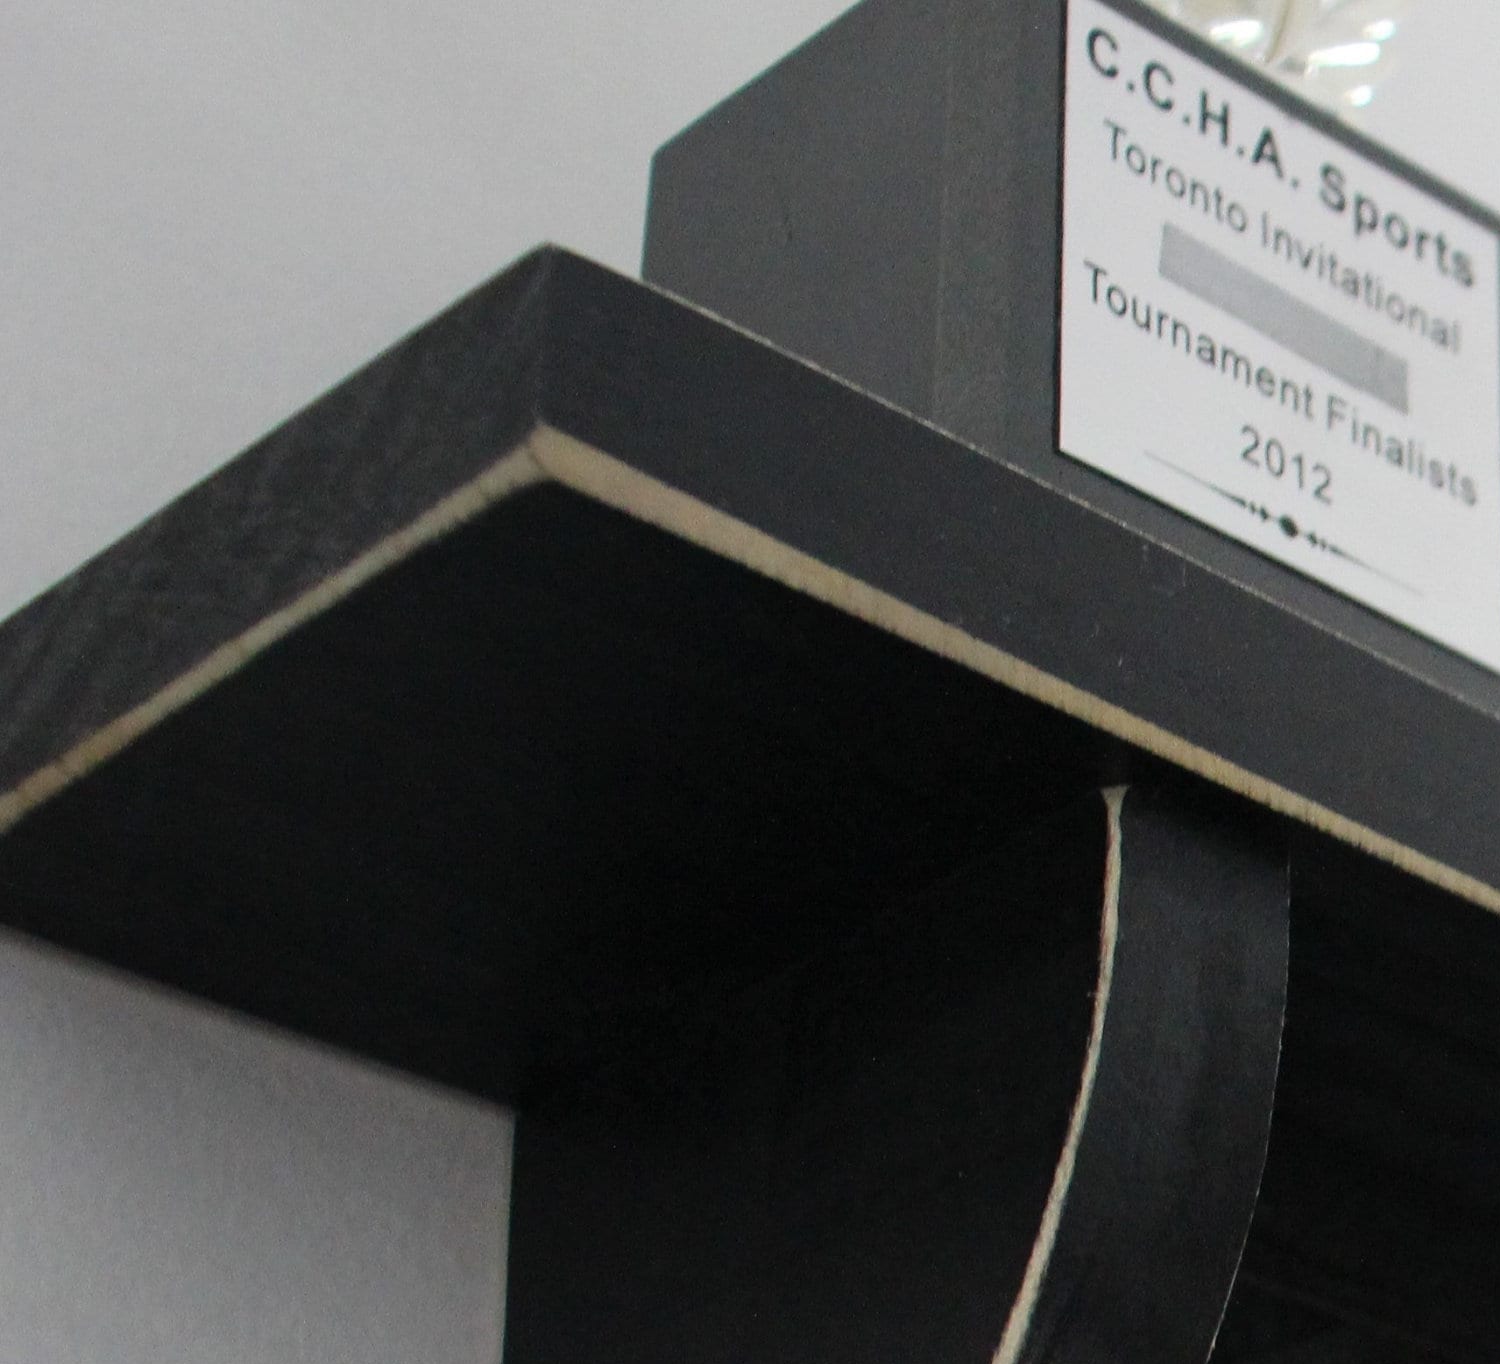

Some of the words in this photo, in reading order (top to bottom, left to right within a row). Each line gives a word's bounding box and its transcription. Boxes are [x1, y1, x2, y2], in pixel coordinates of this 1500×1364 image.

[1086, 26, 1300, 190] C.C.H.A.
[1318, 160, 1476, 289] Sports
[1103, 117, 1248, 234] Toronto
[1260, 209, 1464, 355] Invitational
[1084, 260, 1316, 421] Tournament
[1326, 393, 1479, 507] Finalists
[1239, 424, 1334, 507] 2012
